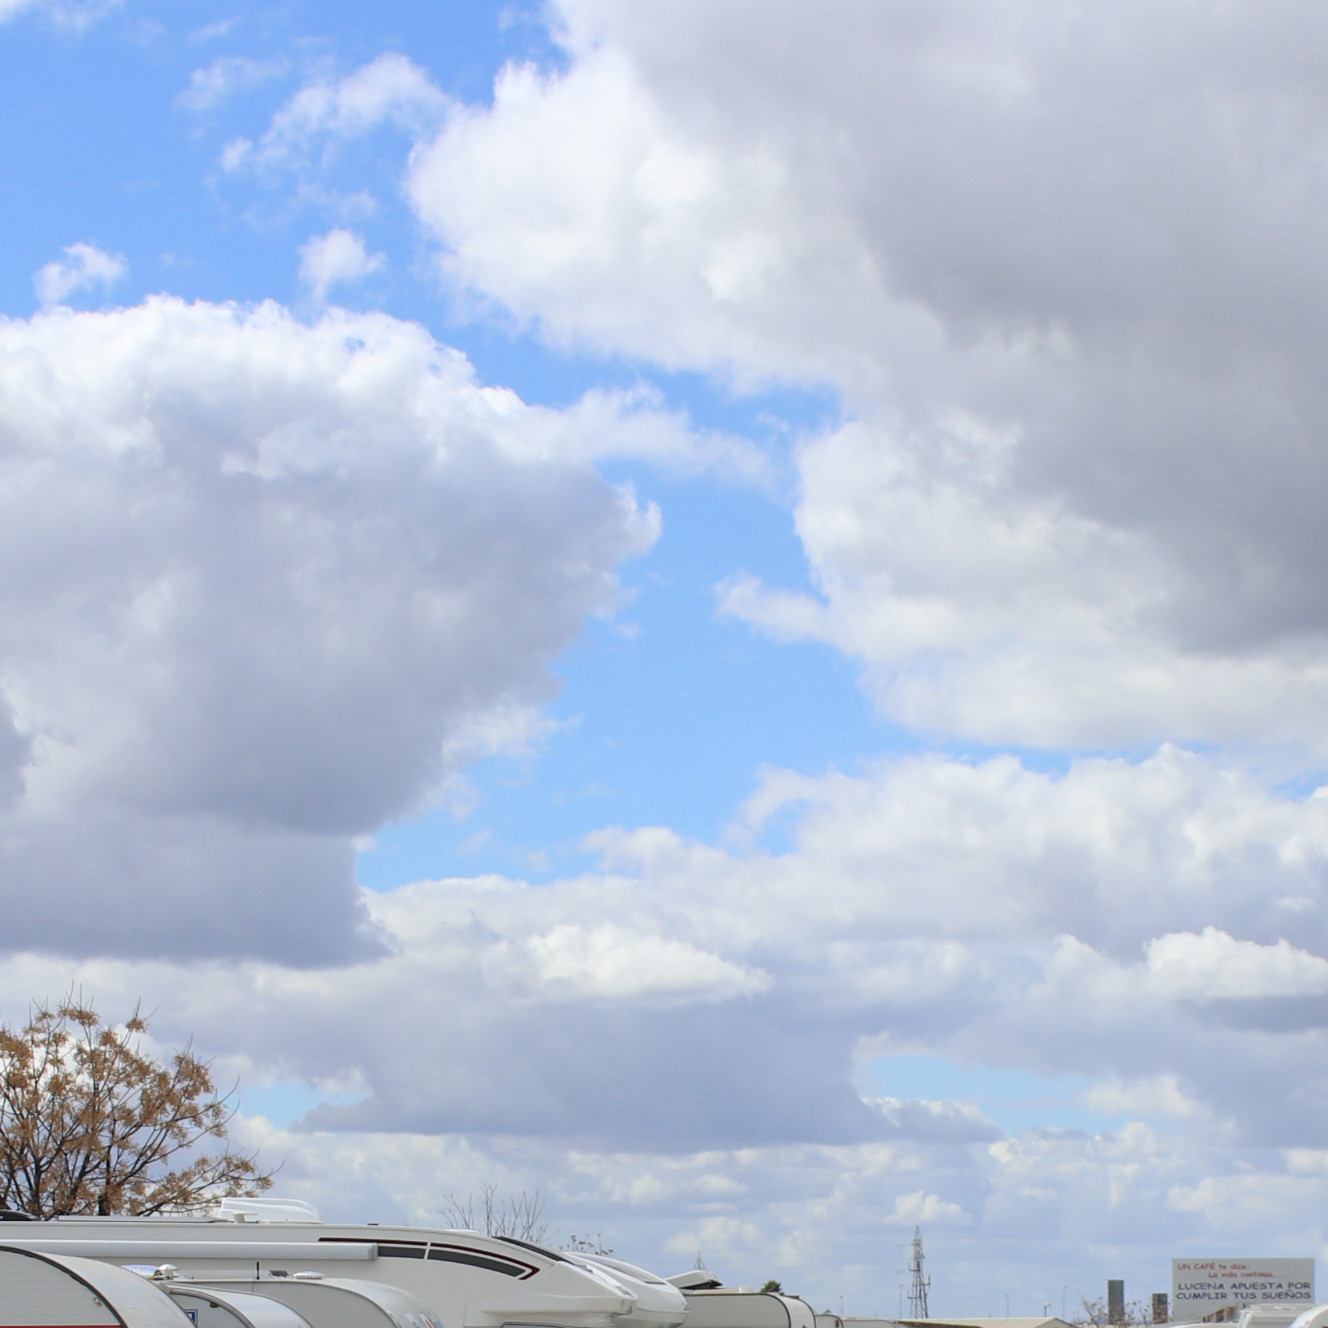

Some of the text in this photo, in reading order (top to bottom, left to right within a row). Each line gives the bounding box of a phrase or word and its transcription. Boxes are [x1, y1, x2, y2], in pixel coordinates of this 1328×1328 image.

[1193, 1261, 1215, 1270] CAFÉ
[1208, 1270, 1218, 1278] La
[1221, 1270, 1238, 1278] vida
[1177, 1281, 1311, 1291] LUCENA APUESTA POR
[1176, 1289, 1312, 1300] CUMPLIR TUS SUEÑOS
